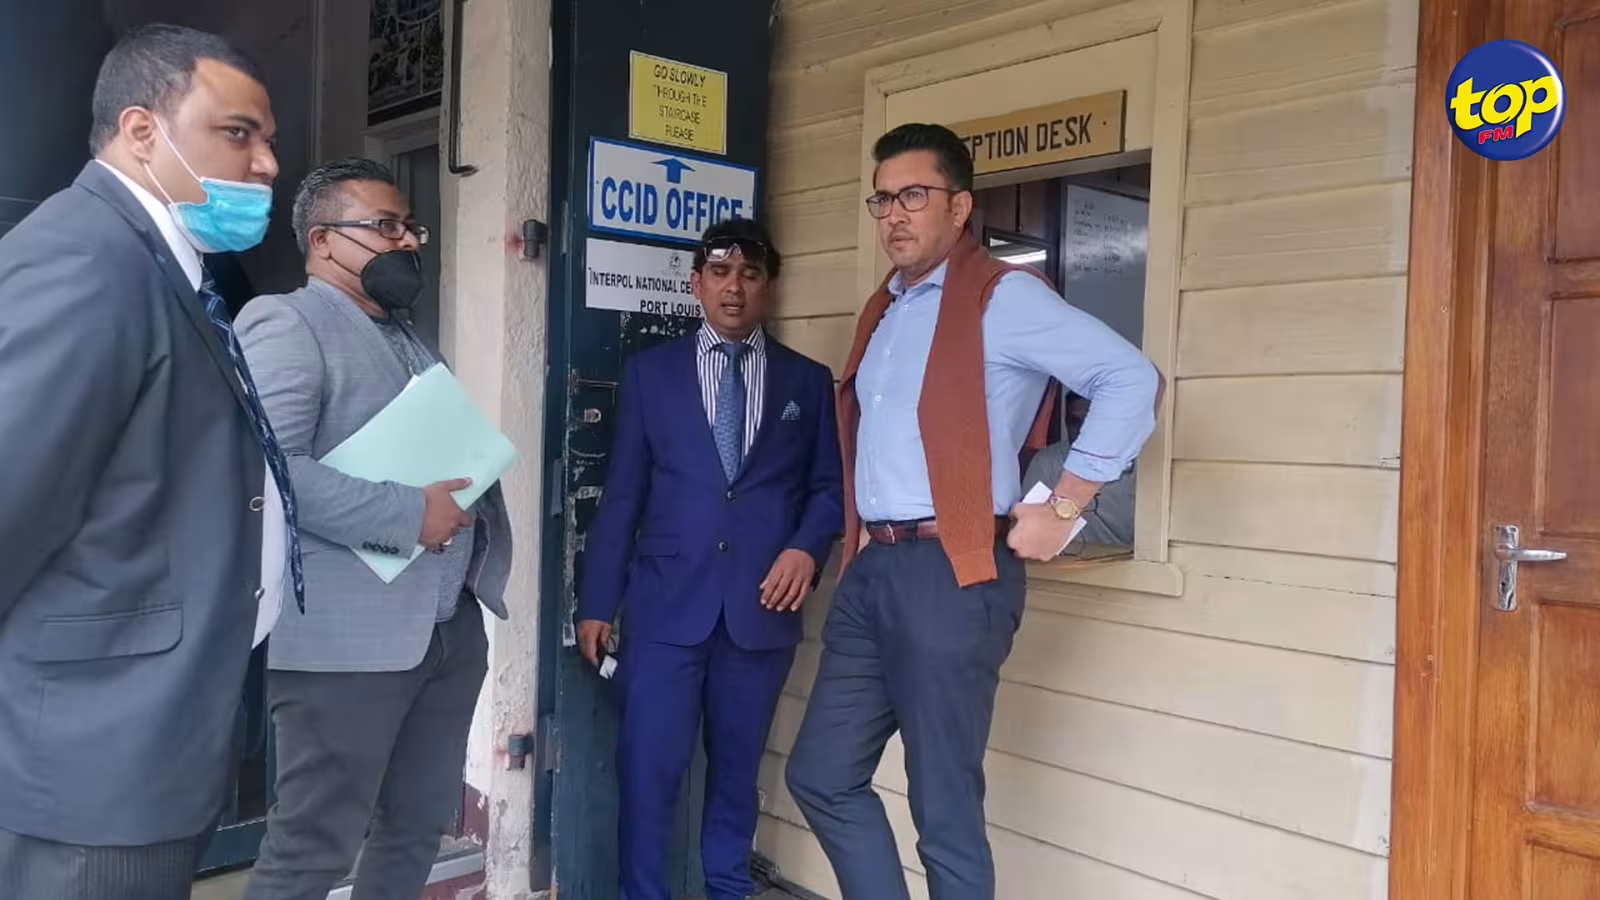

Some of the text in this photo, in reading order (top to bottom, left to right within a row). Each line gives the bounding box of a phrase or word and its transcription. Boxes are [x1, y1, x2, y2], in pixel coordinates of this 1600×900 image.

[653, 64, 706, 88] GO SLOWLY
[692, 93, 707, 108] THE
[658, 105, 701, 125] STAIRCASE
[665, 124, 694, 142] PLEASE
[1036, 112, 1093, 152] DESK
[601, 176, 658, 226] CCID
[589, 269, 633, 289] INTERPOL
[636, 275, 678, 293] NATIONAL
[640, 299, 701, 317] PORT LOUIS
